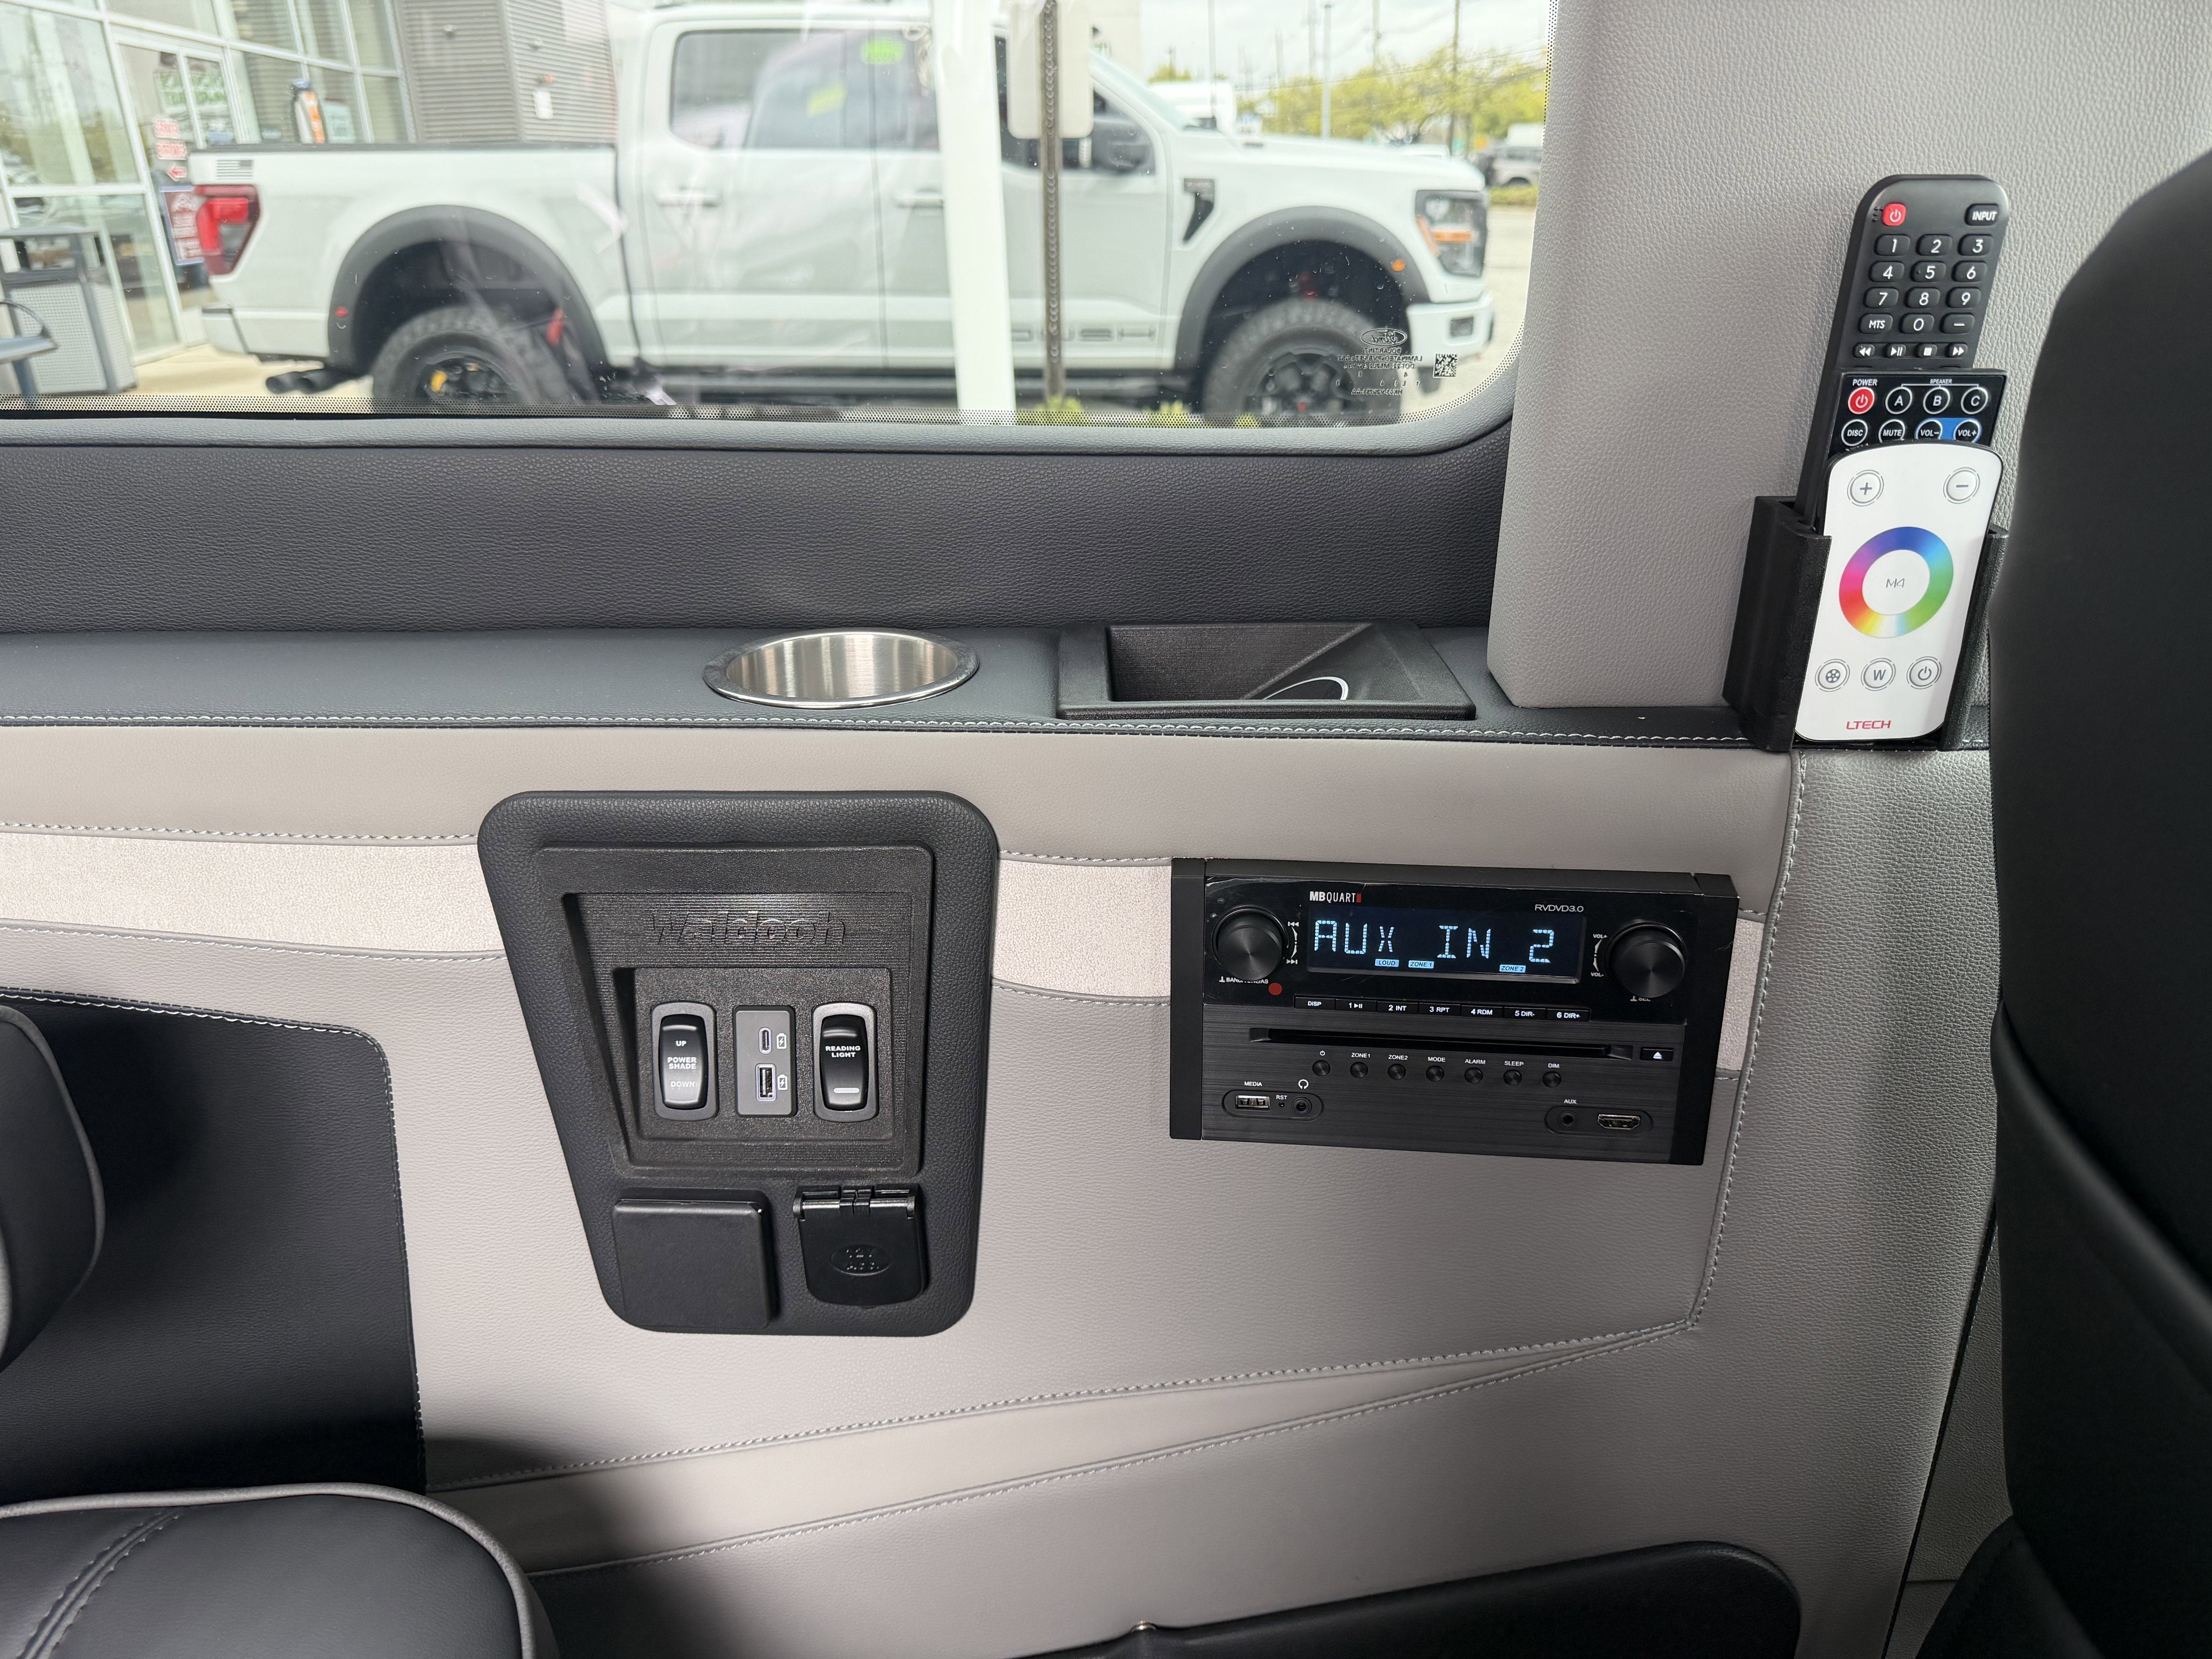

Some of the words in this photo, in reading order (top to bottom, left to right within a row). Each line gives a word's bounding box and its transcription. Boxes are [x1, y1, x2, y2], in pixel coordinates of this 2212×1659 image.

[1973, 211, 1997, 220] INPUT
[1893, 239, 1897, 252] 1
[1931, 239, 1941, 253] 2
[1973, 239, 1983, 252] 3
[1883, 266, 1893, 279] 4
[1925, 266, 1936, 279] 5
[1967, 266, 1976, 279] 6
[1879, 292, 1887, 305] 7
[1919, 292, 1929, 305] 8
[1962, 292, 1970, 305] 9
[1869, 320, 1885, 328] MTS
[1913, 318, 1924, 331] 0
[1894, 395, 1903, 406] A
[1933, 396, 1942, 406] B
[1971, 395, 1980, 406] C
[1874, 670, 1886, 680] W
[1846, 720, 1891, 729] LTECH
[1314, 920, 1394, 954] AUX
[1437, 926, 1491, 958] IN
[1529, 929, 1554, 963] 2
